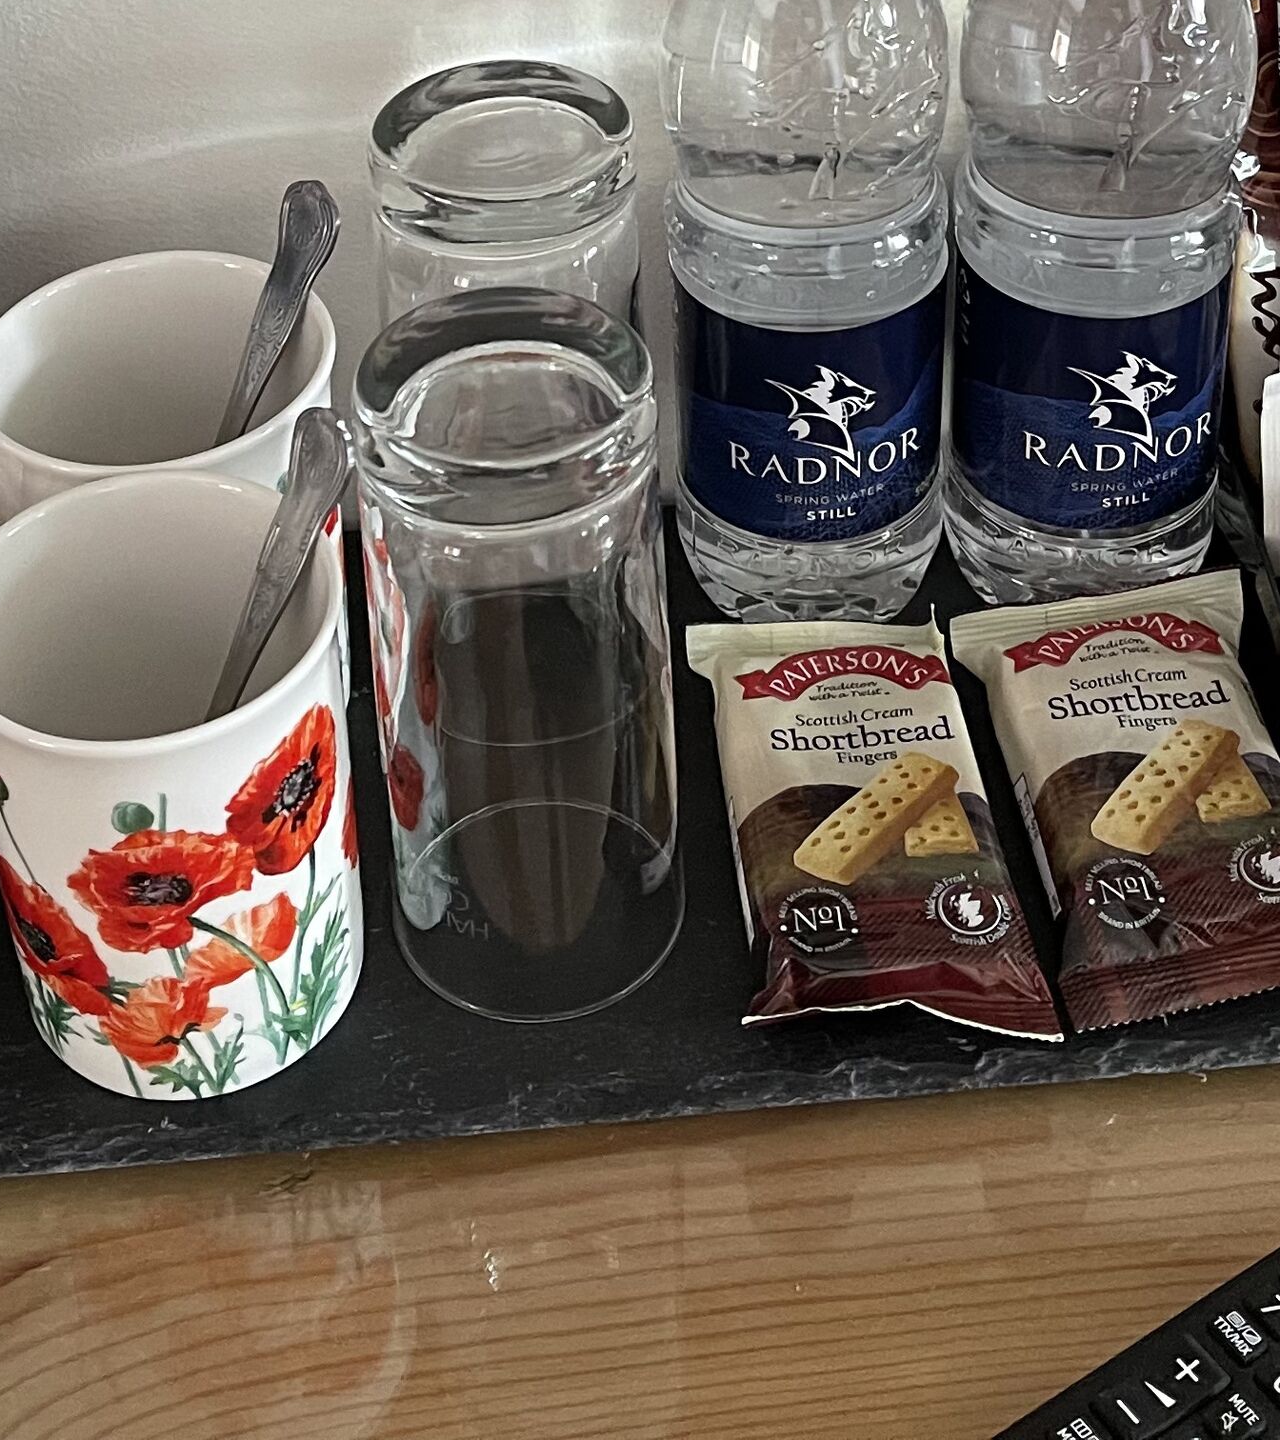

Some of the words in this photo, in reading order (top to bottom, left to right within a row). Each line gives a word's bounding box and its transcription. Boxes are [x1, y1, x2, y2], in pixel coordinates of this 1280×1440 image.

[1023, 412, 1212, 472] RADNOR
[728, 427, 920, 485] RADNOR
[1071, 482, 1127, 493] SPRING
[1132, 468, 1179, 489] WATER
[775, 493, 830, 505] SPRING
[835, 484, 885, 504] WATER
[1102, 492, 1151, 509] STILL
[806, 506, 857, 521] STILL
[1085, 636, 1147, 653] Tradition
[769, 650, 929, 696] PATERSON'S
[1069, 668, 1133, 691] Scottish
[1134, 667, 1187, 683] Cream
[816, 680, 878, 693] Tradition
[1047, 679, 1231, 720] Shortbread
[795, 710, 858, 727] Scottish
[860, 707, 914, 722] Cream
[1116, 714, 1177, 732] Fingers
[770, 715, 956, 752] Shortbread
[837, 750, 898, 766] Fingers
[1213, 1316, 1253, 1357] TTX/MIX
[1228, 1393, 1260, 1426] MUTE
